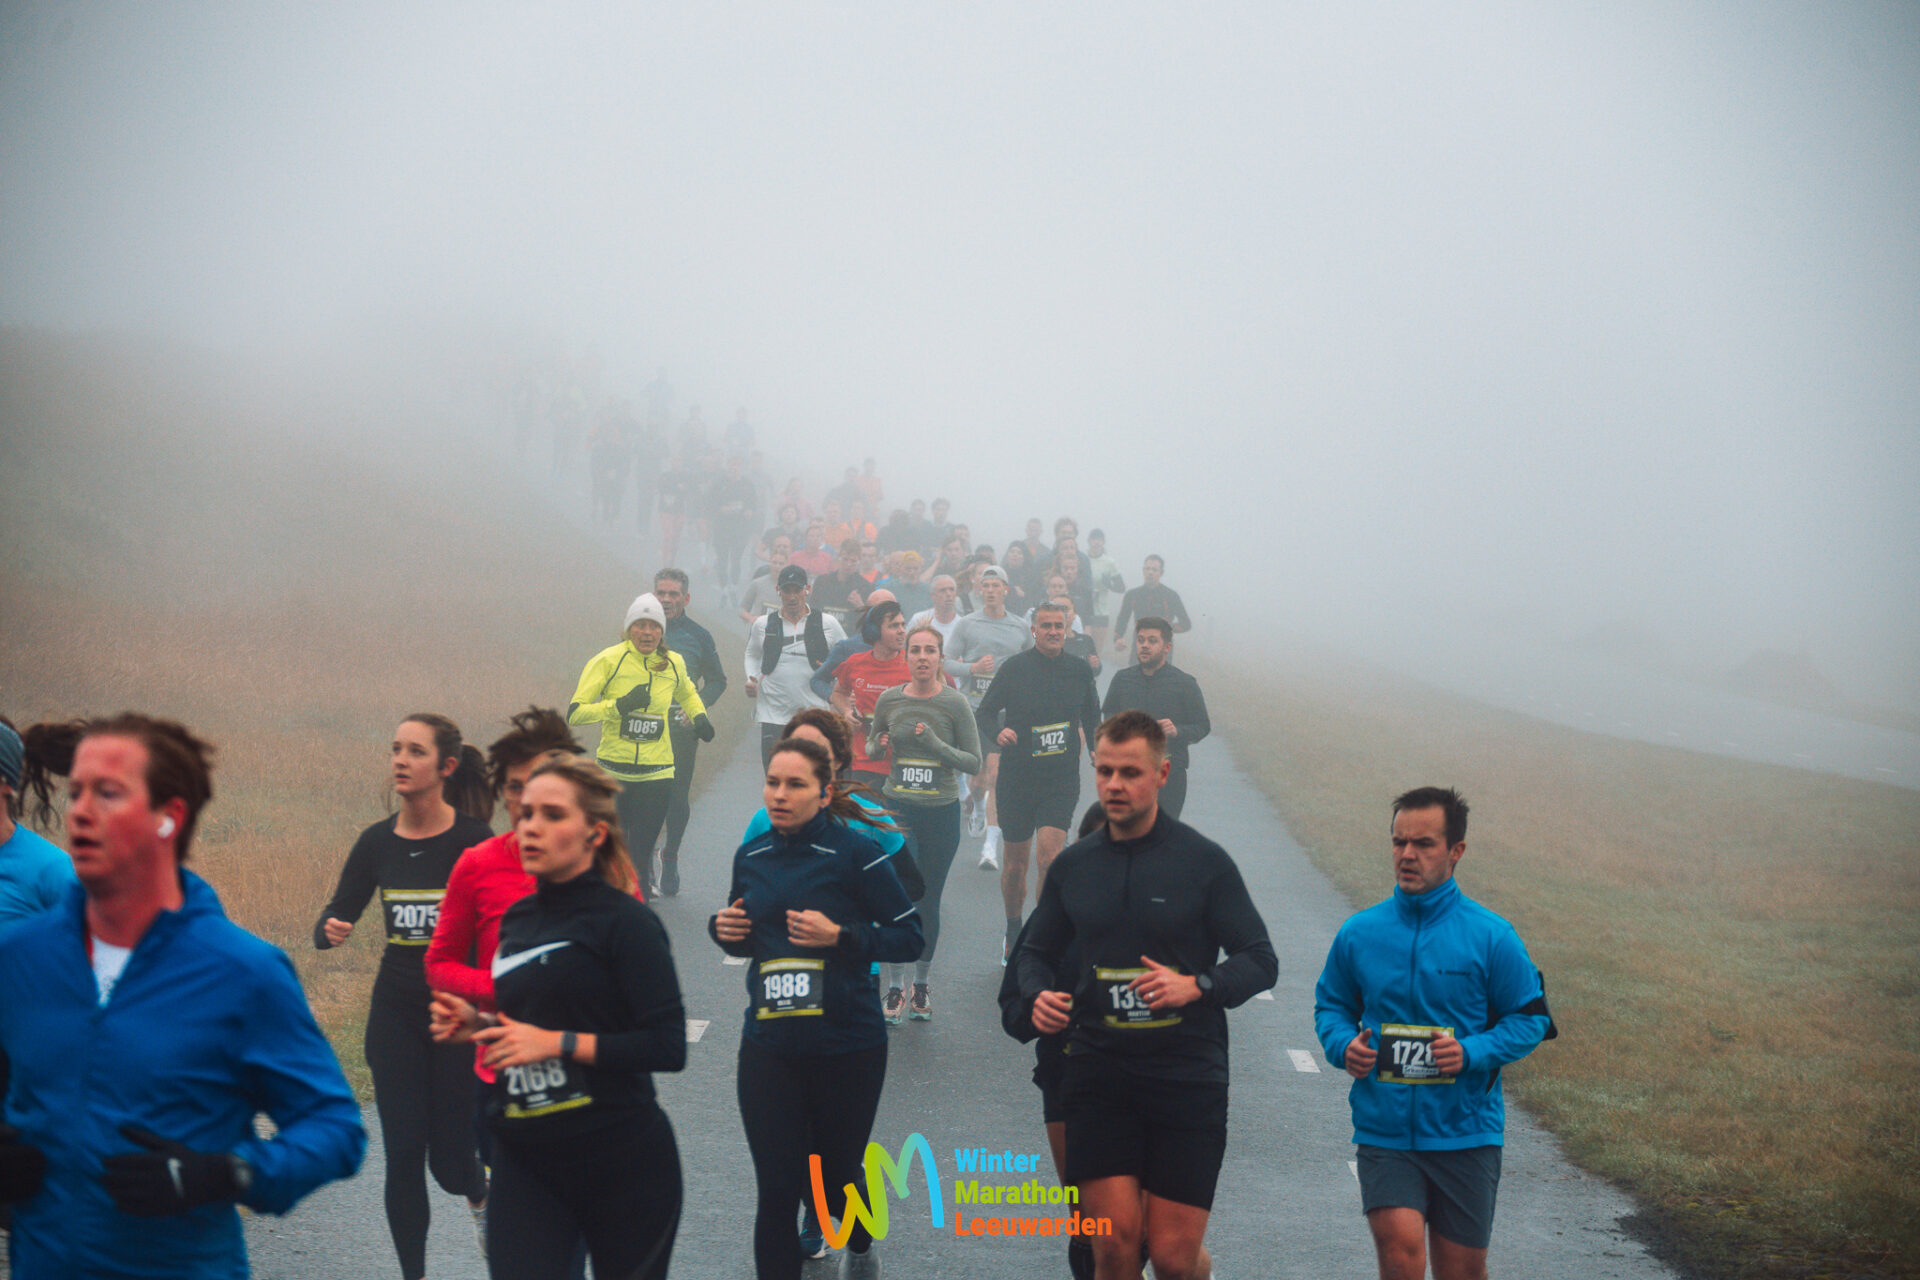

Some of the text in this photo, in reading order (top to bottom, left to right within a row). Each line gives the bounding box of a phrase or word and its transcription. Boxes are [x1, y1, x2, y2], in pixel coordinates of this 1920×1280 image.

[628, 718, 658, 734] 1085
[1039, 731, 1065, 747] 1472
[902, 767, 933, 784] 1050
[392, 904, 440, 928] 2075
[763, 972, 810, 1000] 1988
